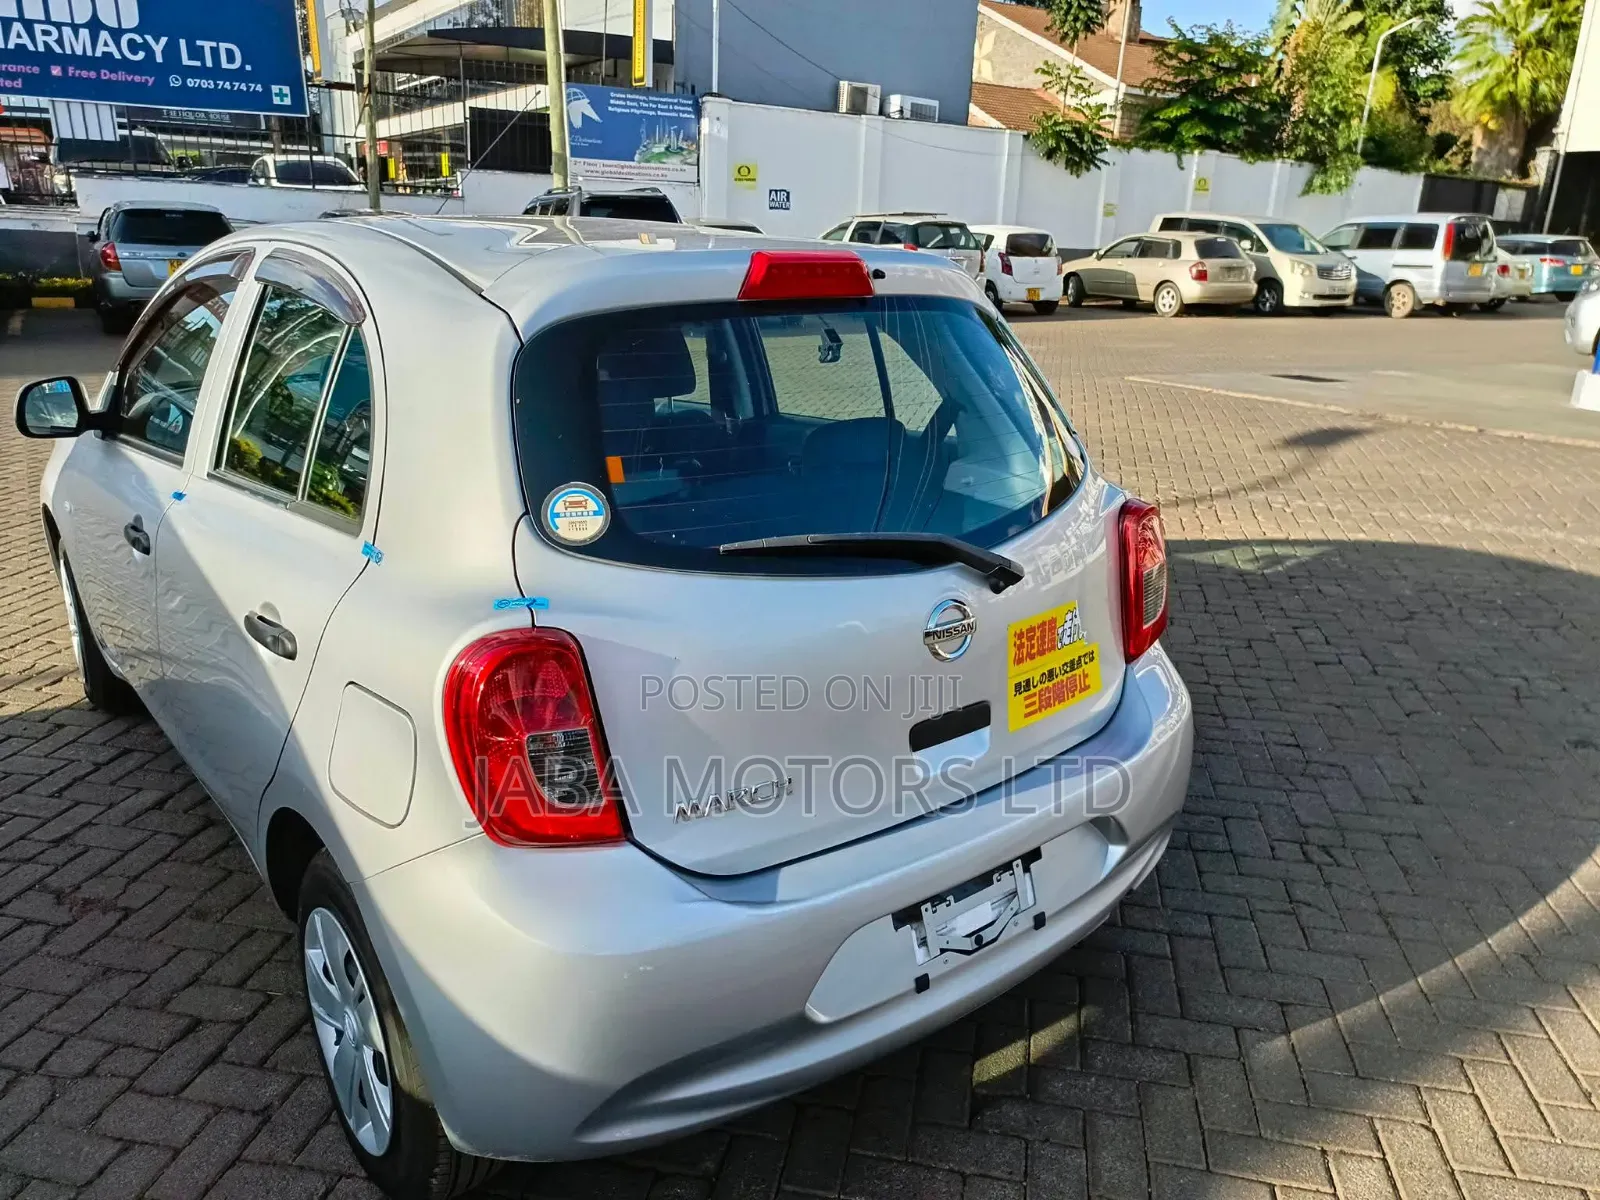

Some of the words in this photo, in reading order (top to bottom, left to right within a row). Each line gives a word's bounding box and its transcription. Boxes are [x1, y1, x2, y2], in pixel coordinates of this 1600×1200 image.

[0, 20, 168, 63] ARMACY
[179, 38, 252, 71] LTD.
[0, 64, 40, 74] rance
[68, 66, 97, 79] Free
[100, 69, 155, 87] Delivery
[186, 78, 215, 89] 0703
[770, 191, 787, 202] AIR
[932, 621, 974, 640] NISSAN
[1013, 649, 1095, 697] 見通しの悪い交差点では
[1023, 668, 1091, 718] 三段階停止
[673, 776, 793, 824] MARCH
